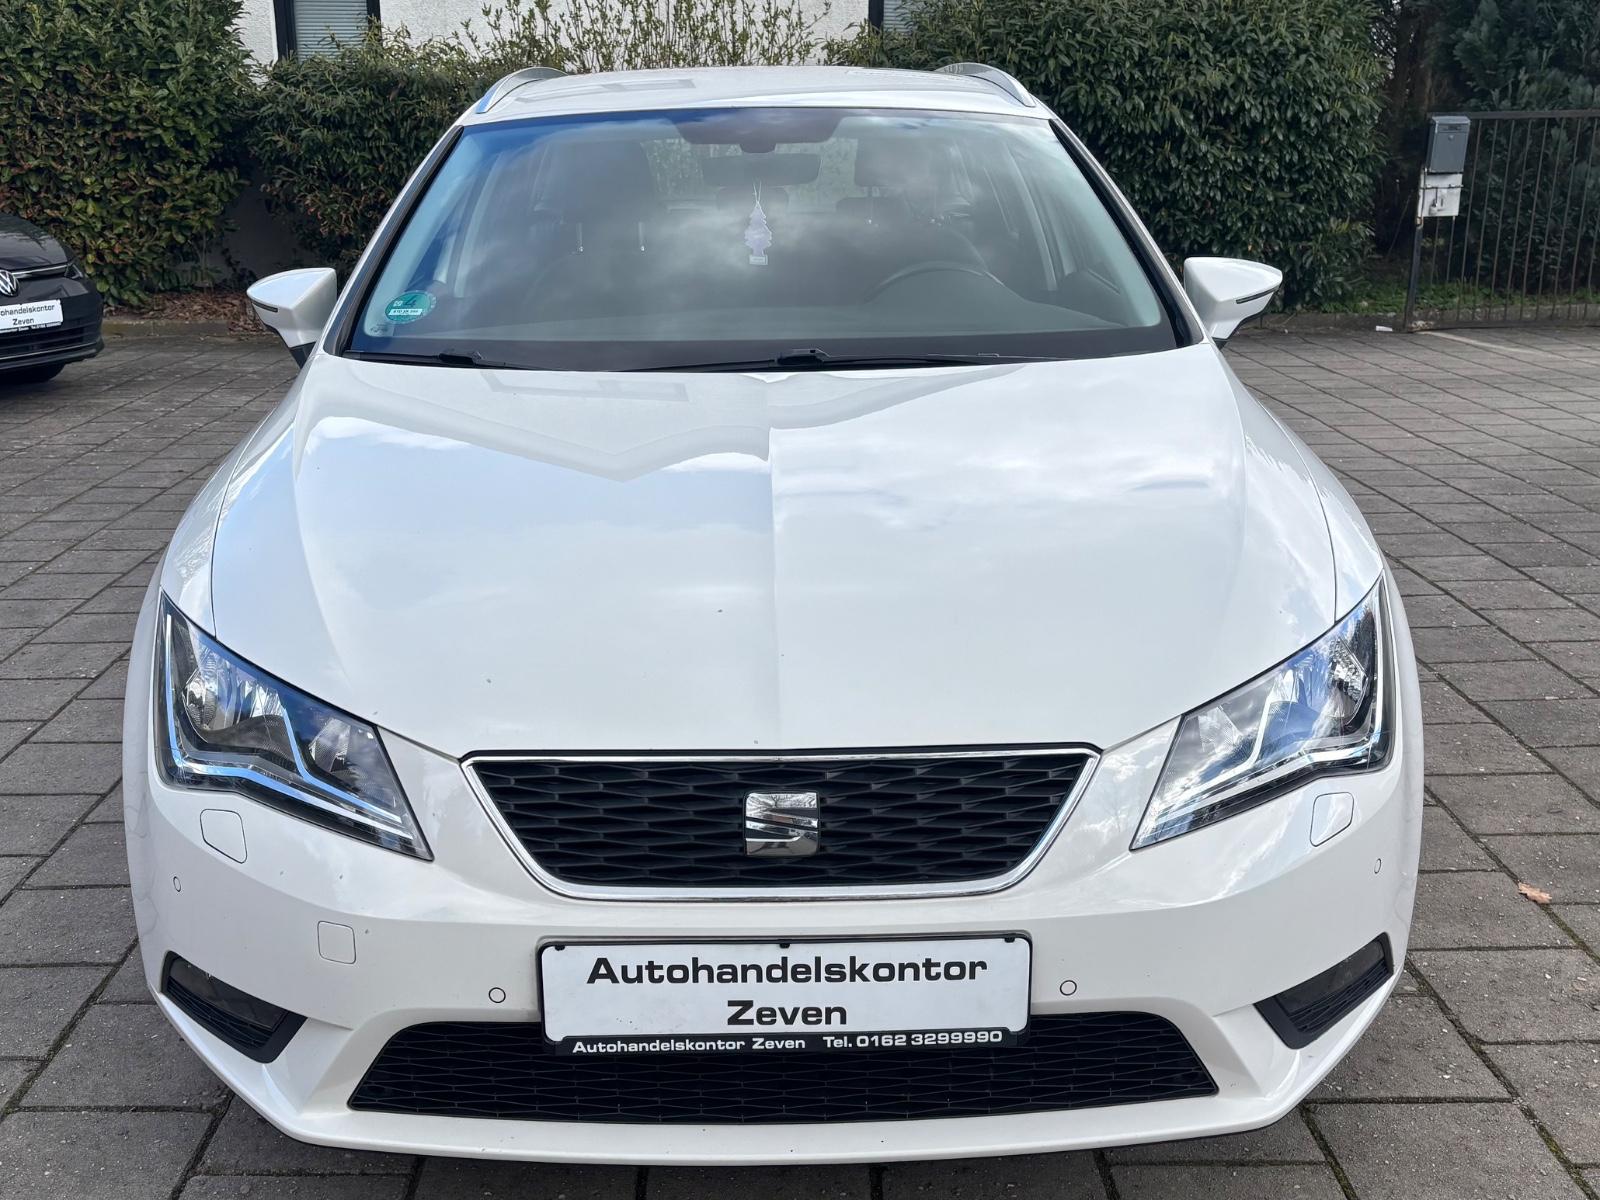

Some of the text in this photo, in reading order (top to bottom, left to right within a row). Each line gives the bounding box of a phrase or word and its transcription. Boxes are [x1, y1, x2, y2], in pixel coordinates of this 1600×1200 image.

[12, 317, 35, 326] Zeven
[586, 955, 988, 985] Autohandelskontor
[727, 999, 848, 1027] Zeven
[572, 1030, 1003, 1054] Autohandelskontor Zeven Tel. 0162 3299990
